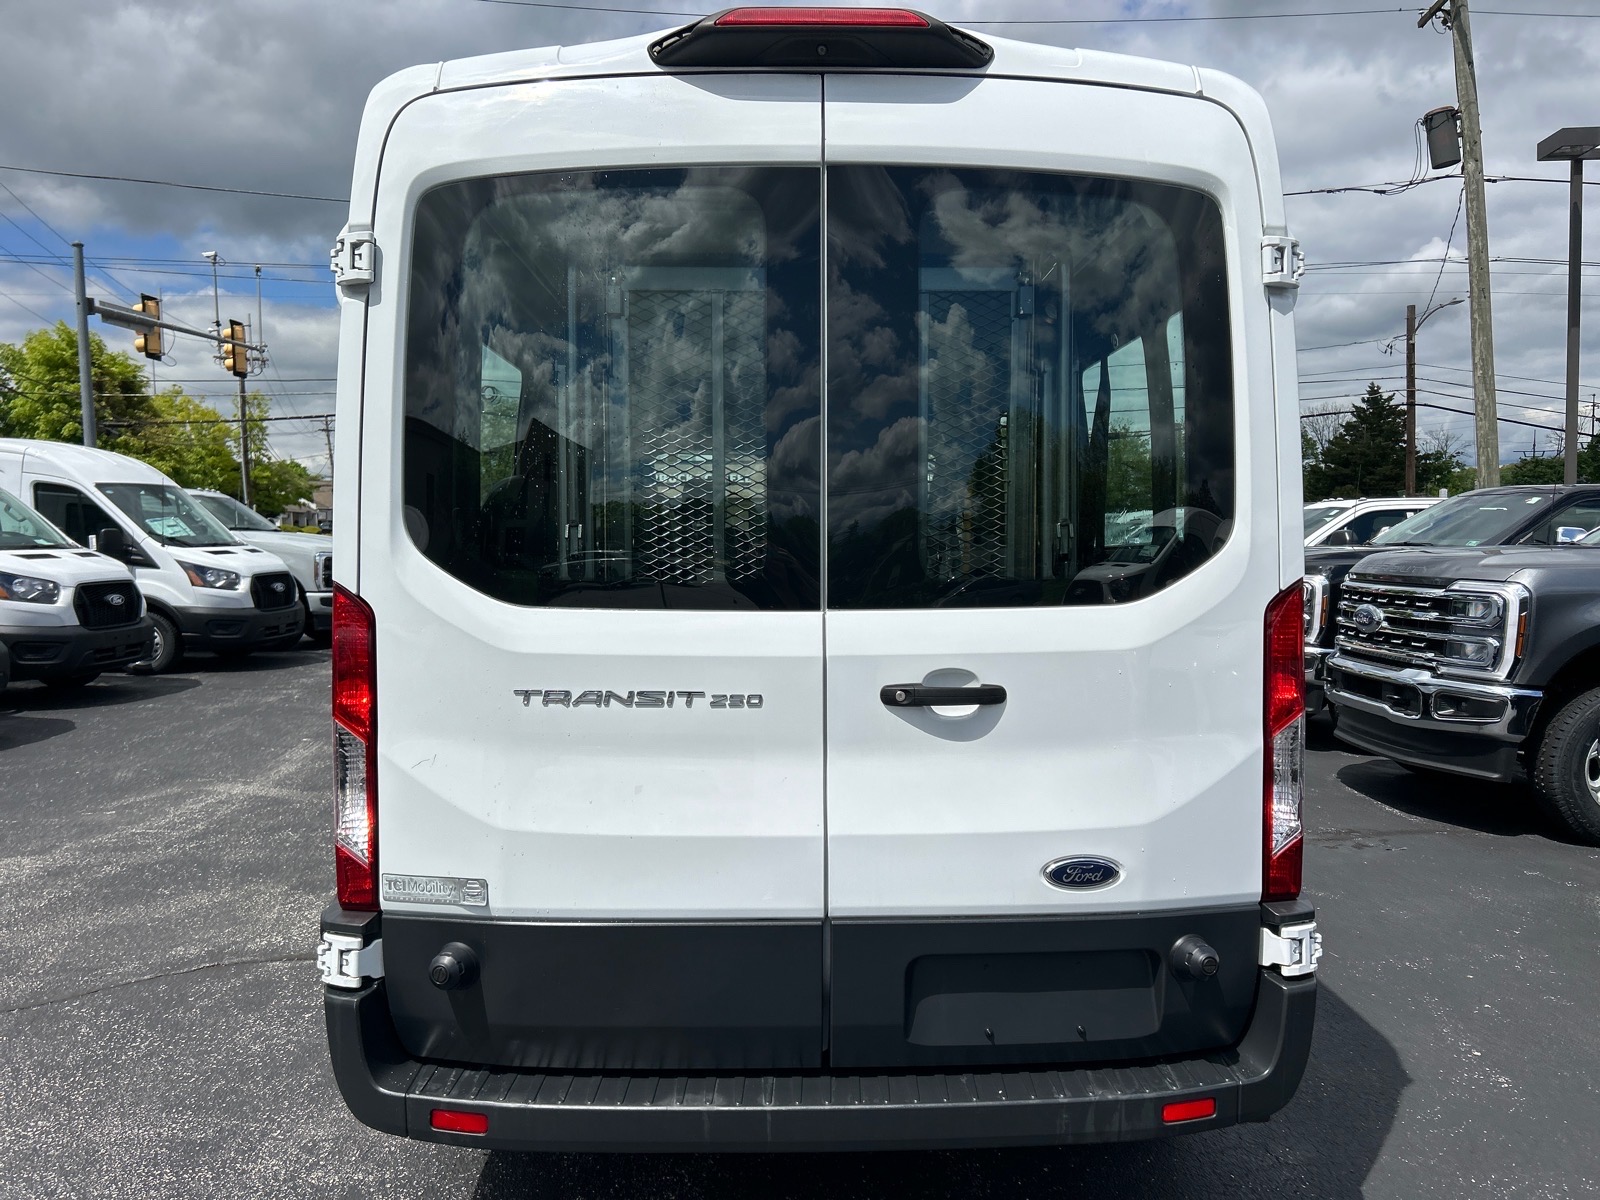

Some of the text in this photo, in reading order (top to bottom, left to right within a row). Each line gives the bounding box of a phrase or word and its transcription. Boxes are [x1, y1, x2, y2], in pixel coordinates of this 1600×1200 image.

[513, 689, 764, 709] TRANSIT 250
[1062, 865, 1104, 882] Ford
